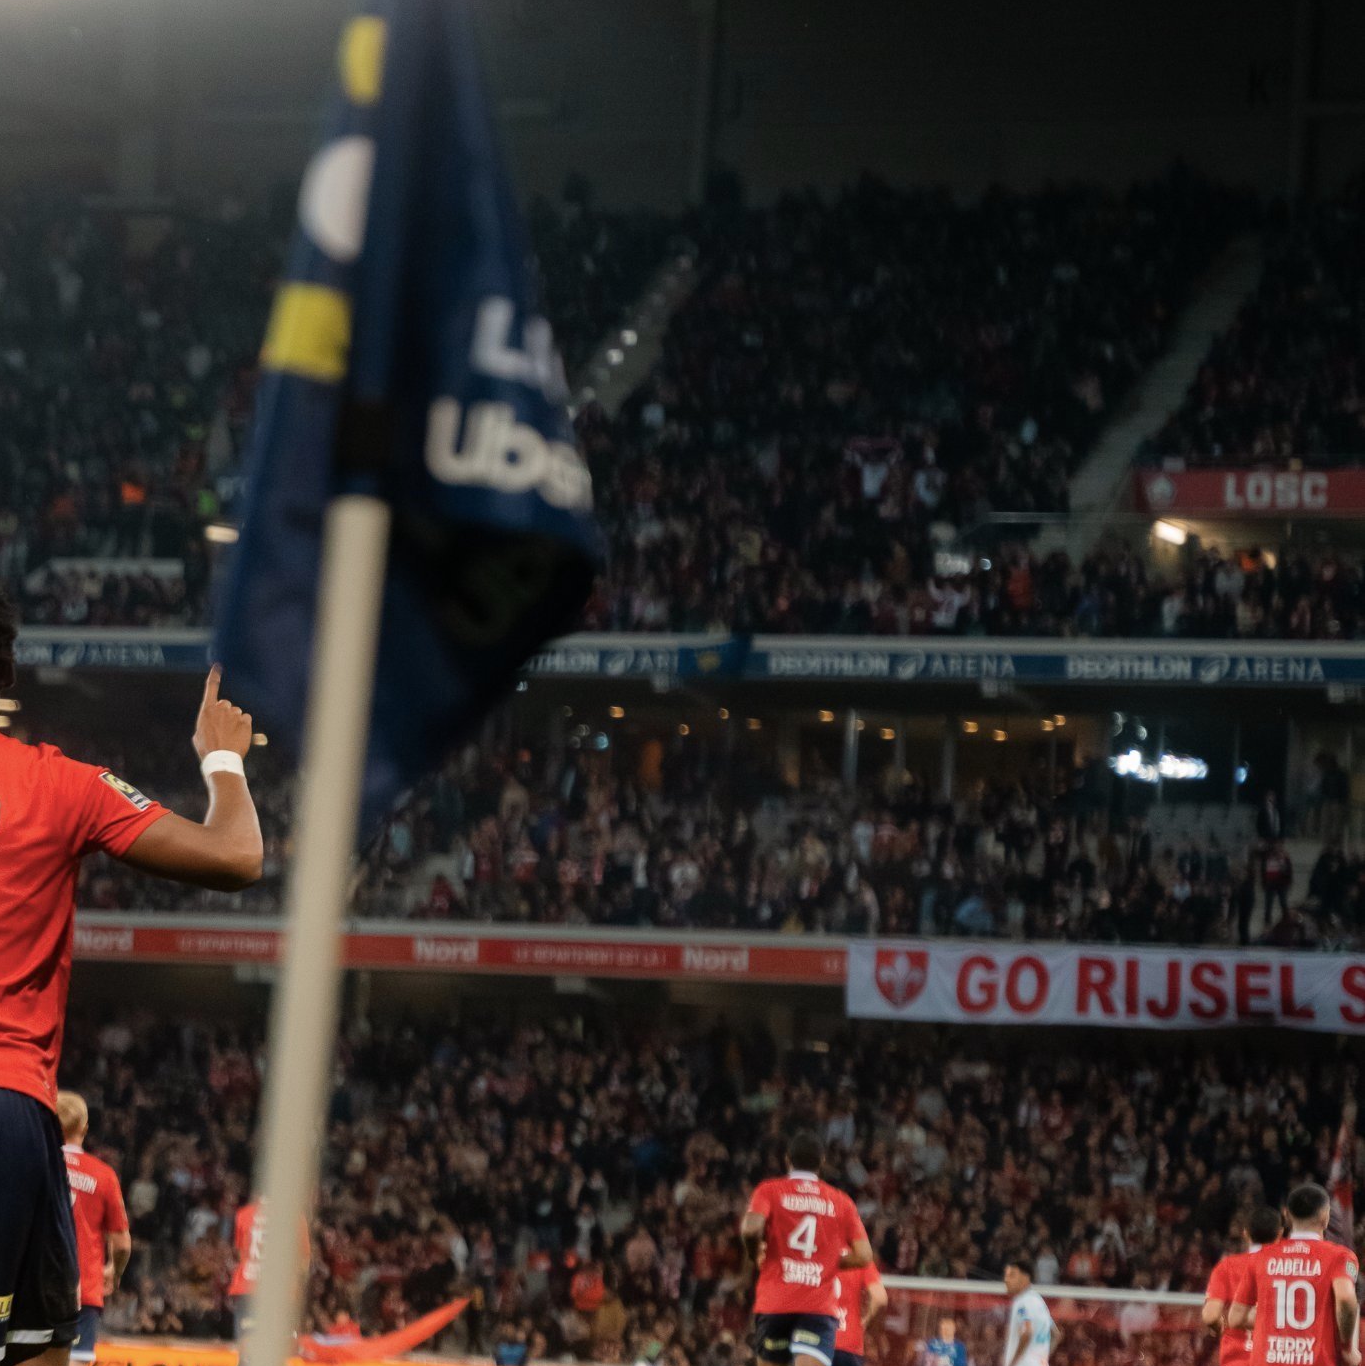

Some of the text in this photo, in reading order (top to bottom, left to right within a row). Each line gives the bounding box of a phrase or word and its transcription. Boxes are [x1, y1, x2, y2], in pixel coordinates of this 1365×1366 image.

[1224, 472, 1329, 509] LOSC
[86, 646, 165, 667] ARENA
[767, 654, 1016, 676] DECATHLON ARENA
[1066, 657, 1326, 681] DECATHLON ARENA
[414, 939, 477, 964] Nord
[682, 948, 749, 972] Nord
[956, 956, 1050, 1015] GO
[1073, 958, 1316, 1020] RIJSEL
[787, 1217, 817, 1260] 4
[781, 1257, 824, 1276] TEDDY
[783, 1272, 821, 1288] SMITH
[1272, 1279, 1316, 1331] 10
[1267, 1337, 1316, 1353] TEDDY
[1266, 1350, 1314, 1366] SMITH
